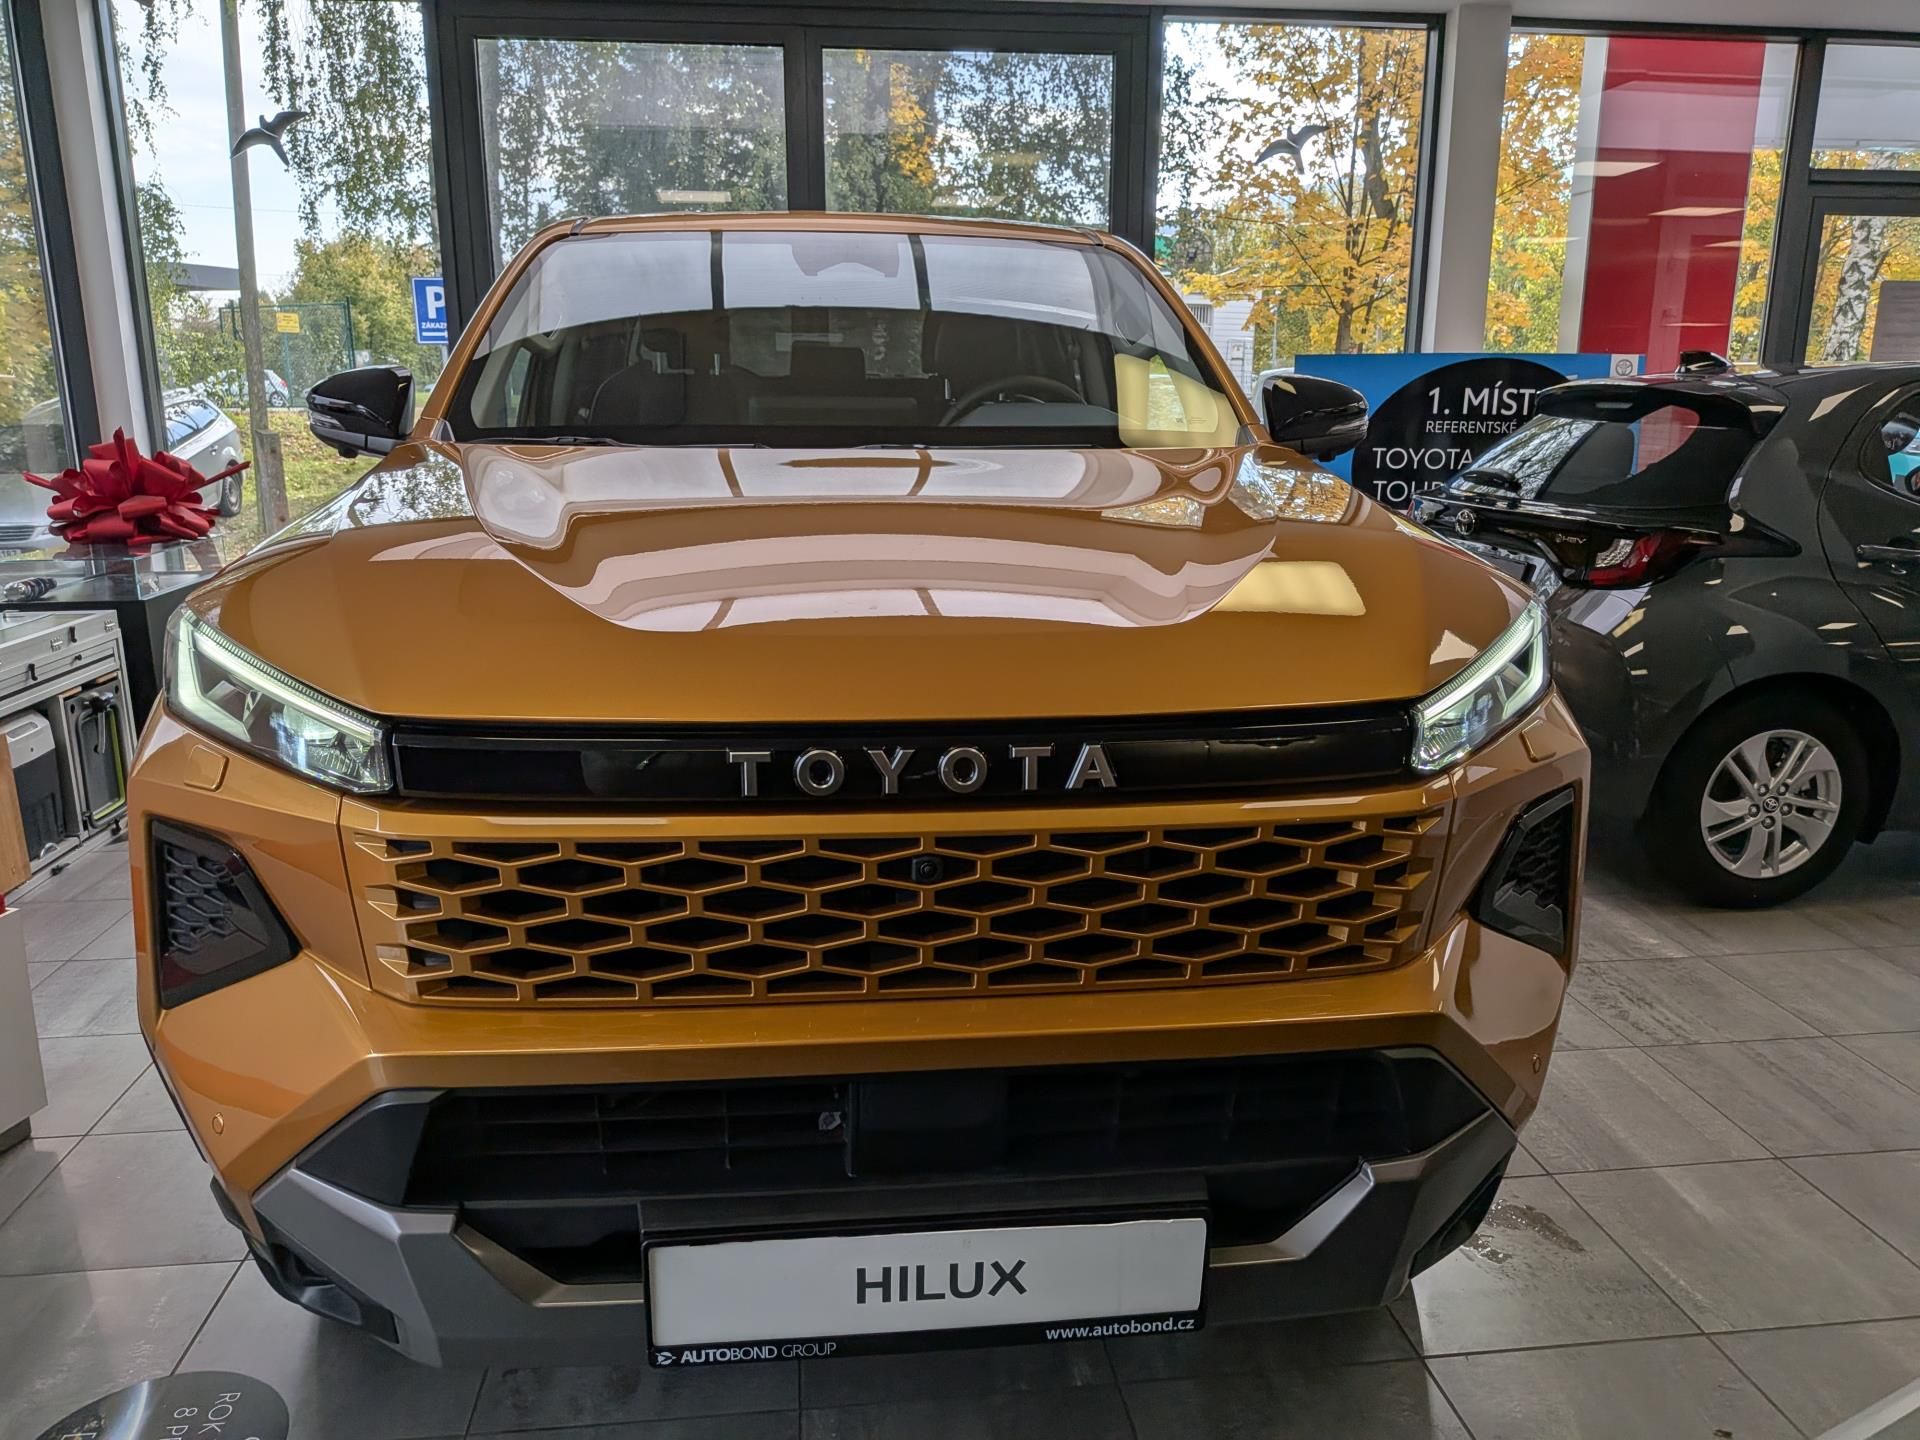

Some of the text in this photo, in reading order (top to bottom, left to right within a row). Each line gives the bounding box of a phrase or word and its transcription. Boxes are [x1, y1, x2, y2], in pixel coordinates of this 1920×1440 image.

[425, 286, 445, 319] P
[1428, 380, 1536, 416] 1. MÍST
[1425, 418, 1518, 434] REFERENTSKÉ
[1372, 447, 1473, 470] TOYOTA
[726, 743, 1118, 797] TOYOTA
[856, 1259, 1028, 1305] HILUX
[1046, 1317, 1195, 1341] www.autobond.cz
[680, 1341, 837, 1364] AUTOBOND GROUP
[174, 1407, 198, 1418] 8
[198, 1392, 241, 1434] ROK
